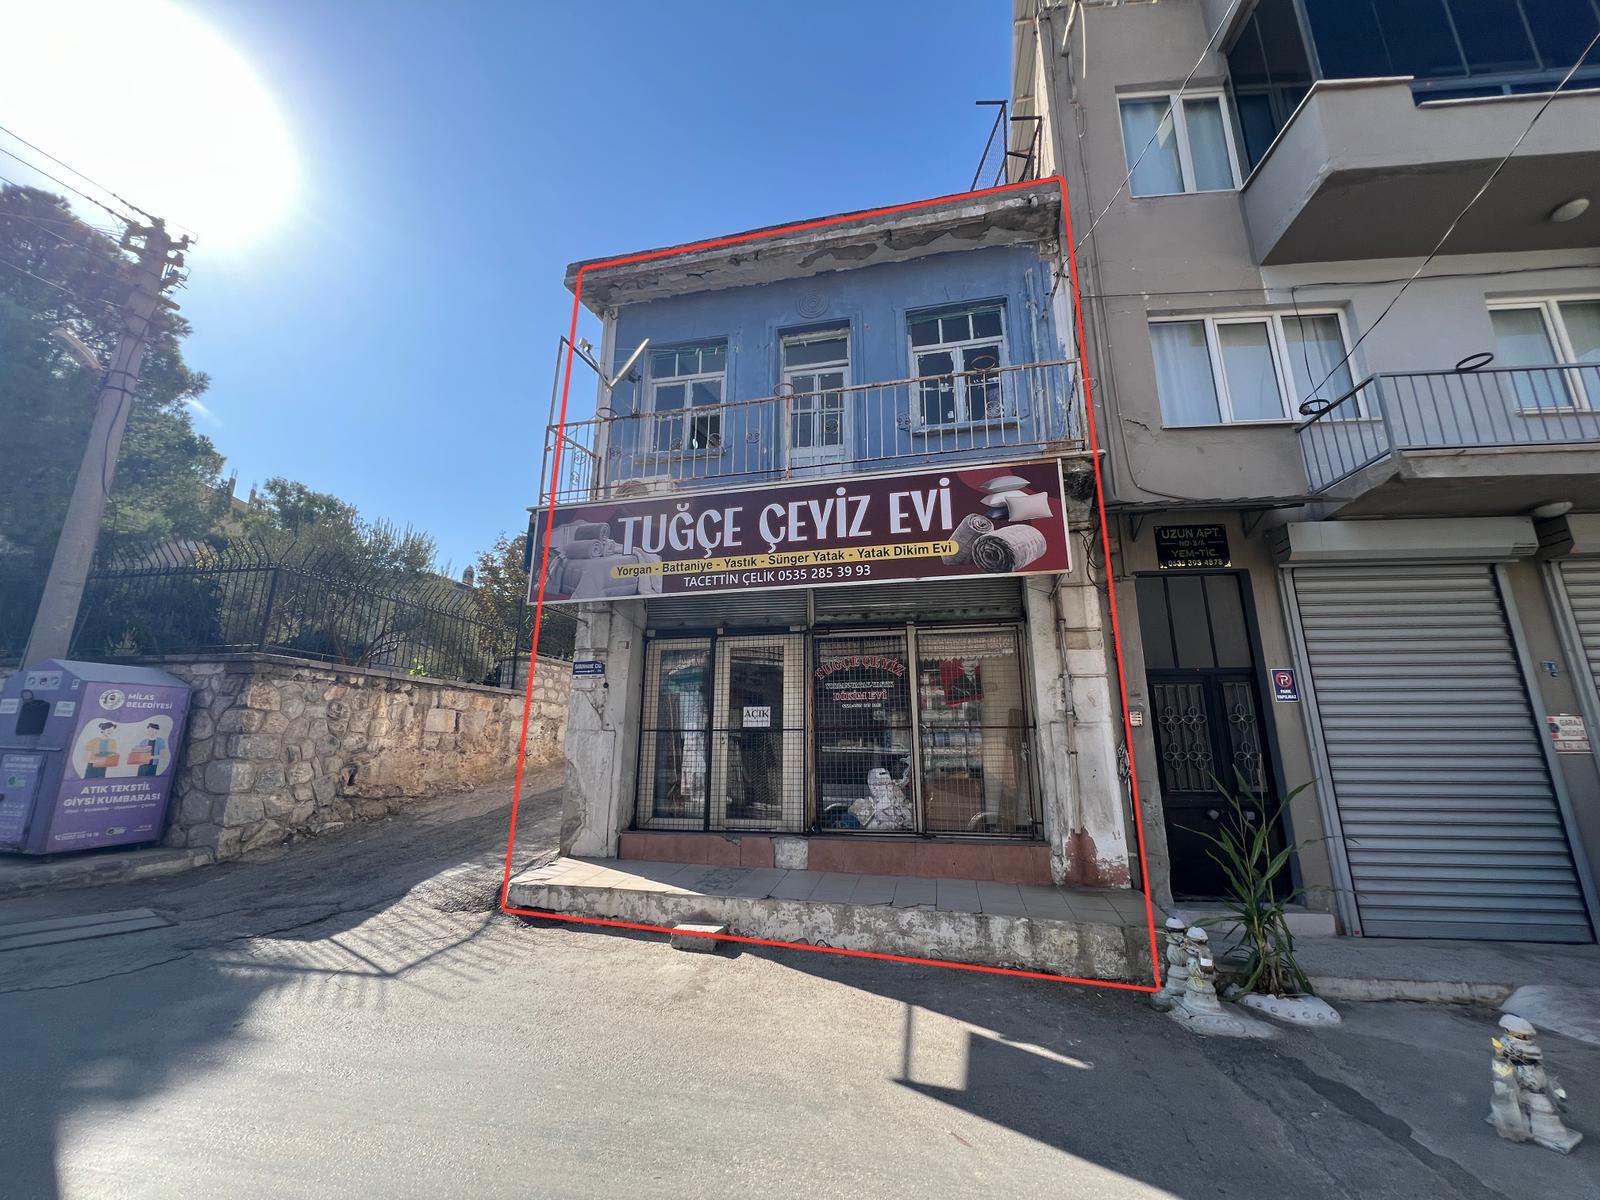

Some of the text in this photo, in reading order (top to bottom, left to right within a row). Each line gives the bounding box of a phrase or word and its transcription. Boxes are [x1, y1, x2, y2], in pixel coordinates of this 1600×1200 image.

[618, 477, 953, 558] TUĞÇE ÇEYİZ EVİ
[1161, 527, 1221, 539] UZUN APT.
[616, 565, 652, 577] Yorgan
[662, 560, 713, 573] Battaniye
[724, 556, 757, 568] Yastık
[768, 553, 809, 566] Sünger
[813, 550, 845, 562] Yatak
[857, 547, 890, 559] Yatak
[893, 544, 929, 556] Dikim
[932, 542, 952, 554] Evi
[683, 564, 871, 587] TACETTİN ÇELİK 0535 285 39 93
[128, 692, 154, 701] MİLAS
[126, 700, 173, 710] BELEDİYESİ
[744, 710, 769, 720] AÇIK
[81, 782, 151, 795] ATIK TEKSTİL
[63, 792, 161, 807] GİYSİ KUMBARASI
